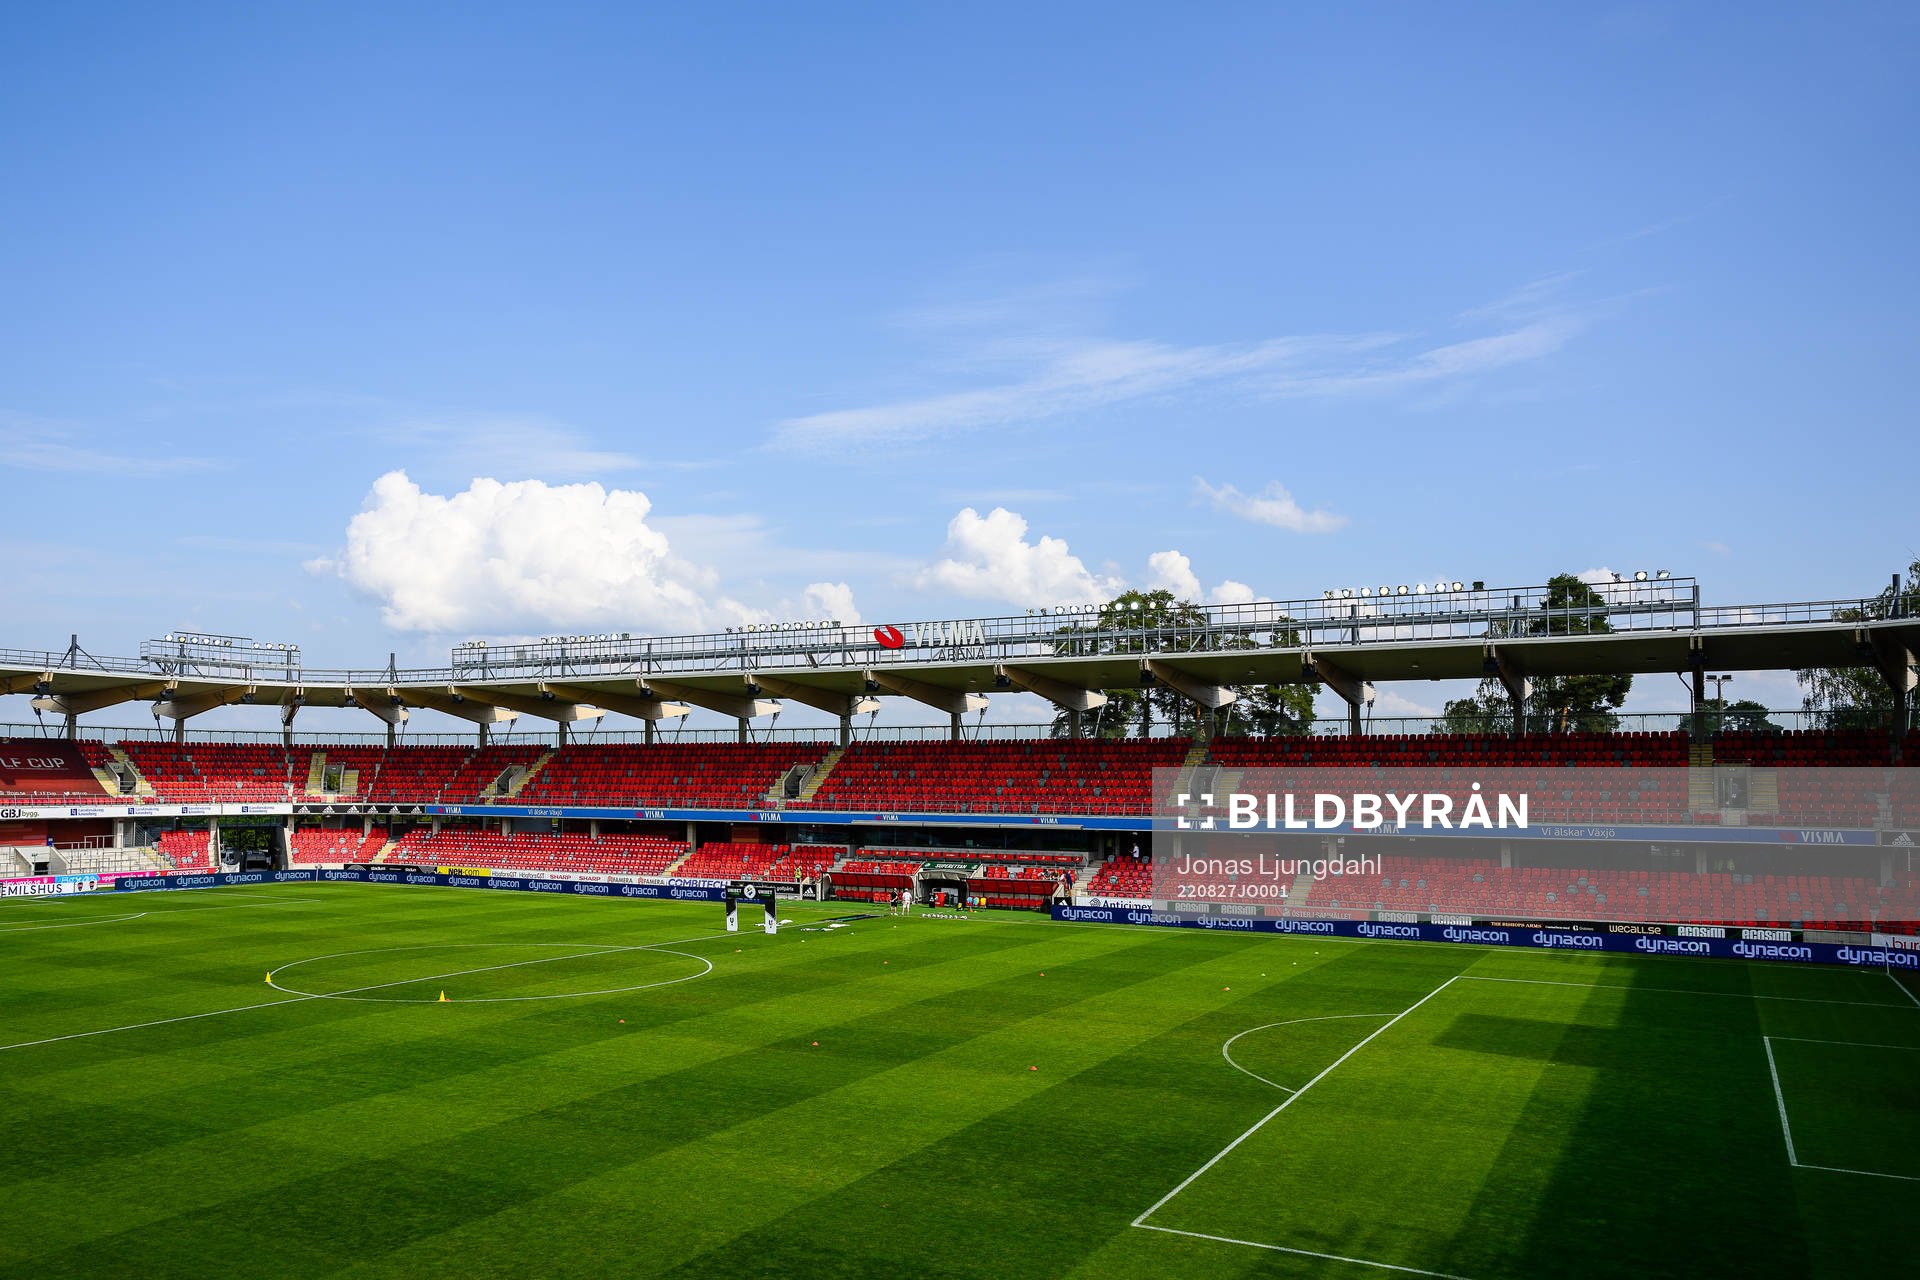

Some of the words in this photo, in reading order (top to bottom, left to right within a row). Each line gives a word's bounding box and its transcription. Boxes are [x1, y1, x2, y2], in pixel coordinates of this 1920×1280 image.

[911, 619, 985, 647] VISMA
[27, 757, 65, 768] CUP
[645, 810, 665, 819] VISMA
[760, 812, 781, 821] VISMA
[1541, 827, 1551, 836] Vi
[1554, 827, 1585, 837] älskar
[1587, 828, 1616, 839] Växjö
[1801, 831, 1845, 843] VISMA
[225, 872, 262, 884] dynacon
[274, 870, 311, 881] dynacon
[325, 870, 360, 880] dynacon
[368, 871, 397, 882] dynacon
[406, 873, 436, 884] dynacon
[448, 875, 480, 886] dynacon
[124, 878, 166, 890] dynacon
[176, 876, 215, 887] dynacon
[488, 877, 520, 889] dynacon
[529, 879, 562, 891] dynacon
[668, 878, 728, 889] COMBITECH
[574, 882, 609, 894] dynacon
[622, 885, 658, 896] dynacon
[670, 887, 708, 899] dynacon
[1061, 906, 1113, 920] dynacon
[1128, 909, 1181, 924] dynacon
[1197, 913, 1253, 928] dynacon
[1275, 918, 1334, 932] dynacon
[1357, 921, 1420, 937] dynacon
[1443, 926, 1509, 942] dynacon
[1532, 931, 1603, 947] dynacon
[1635, 935, 1710, 953] dynacon
[1892, 936, 1920, 950] bur
[1732, 940, 1812, 958] dynacon
[1836, 946, 1918, 965] dynacon
